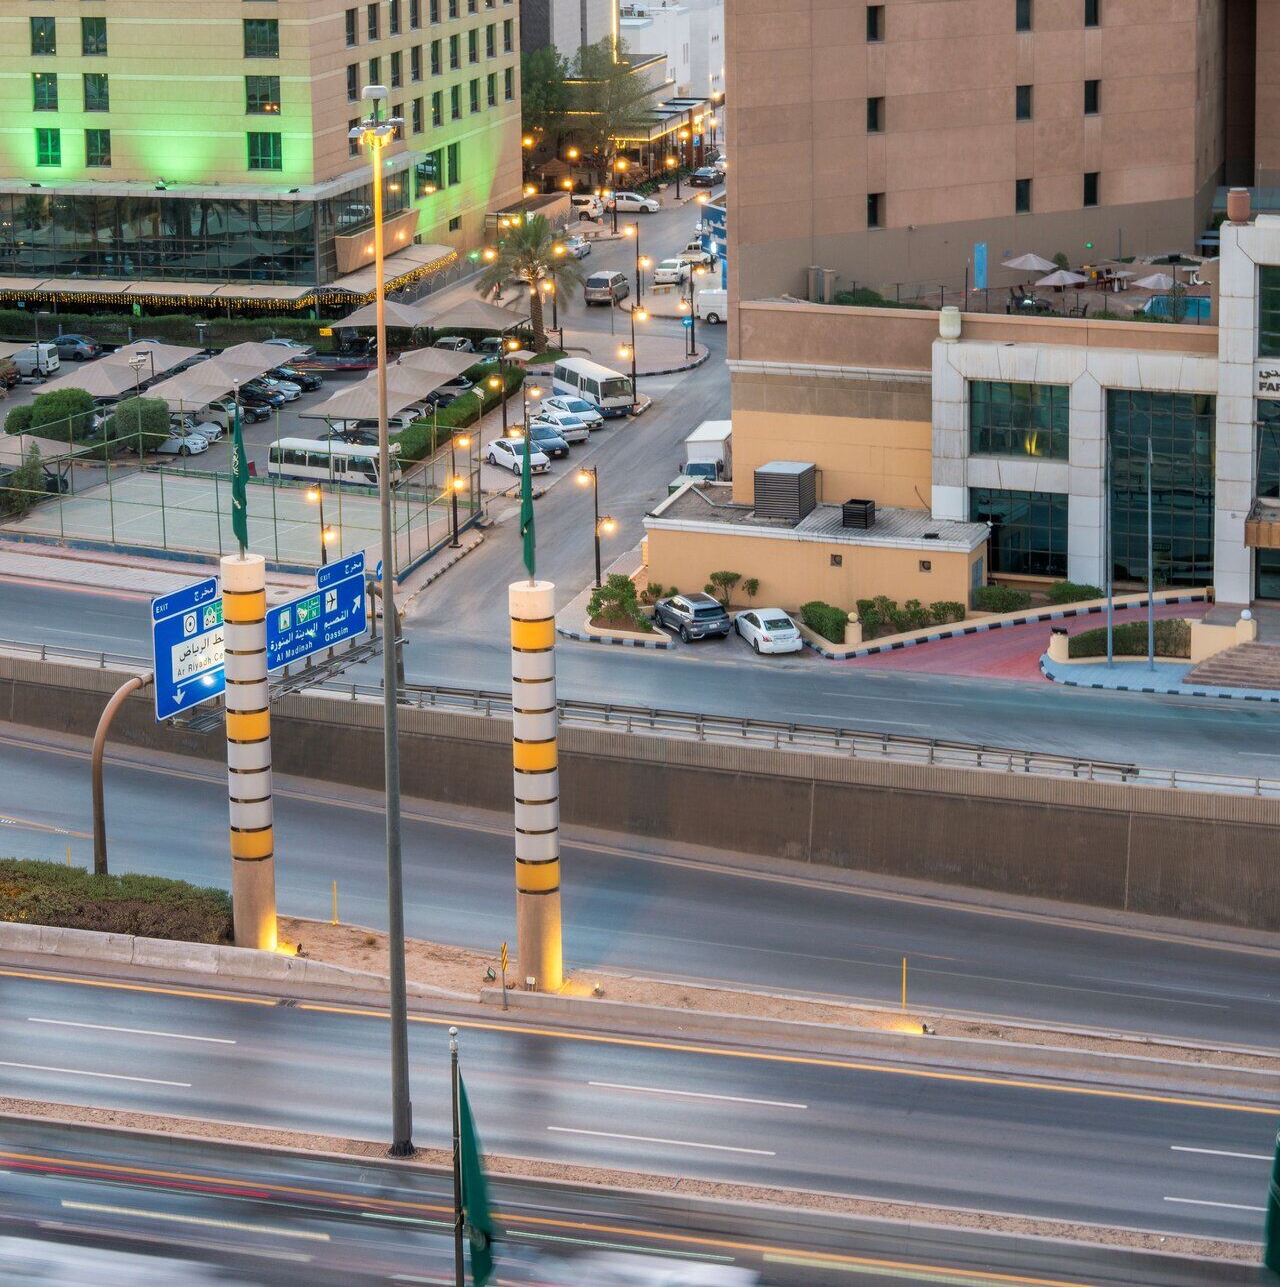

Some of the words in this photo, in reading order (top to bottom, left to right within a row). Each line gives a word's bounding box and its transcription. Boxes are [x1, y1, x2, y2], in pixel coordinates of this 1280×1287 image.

[344, 561, 362, 574] مخرج
[320, 573, 331, 582] EXIT
[194, 586, 214, 602] مخرج
[155, 603, 169, 614] EXIT
[324, 609, 349, 630] القصيم
[295, 622, 318, 640] المدينة
[325, 626, 349, 642] Qassim
[179, 638, 210, 662] الرياض
[270, 632, 294, 651] المنورة
[276, 652, 284, 663] Al
[285, 641, 313, 658] Madinah
[177, 668, 185, 677] Ar
[188, 656, 212, 673] Riyadh
